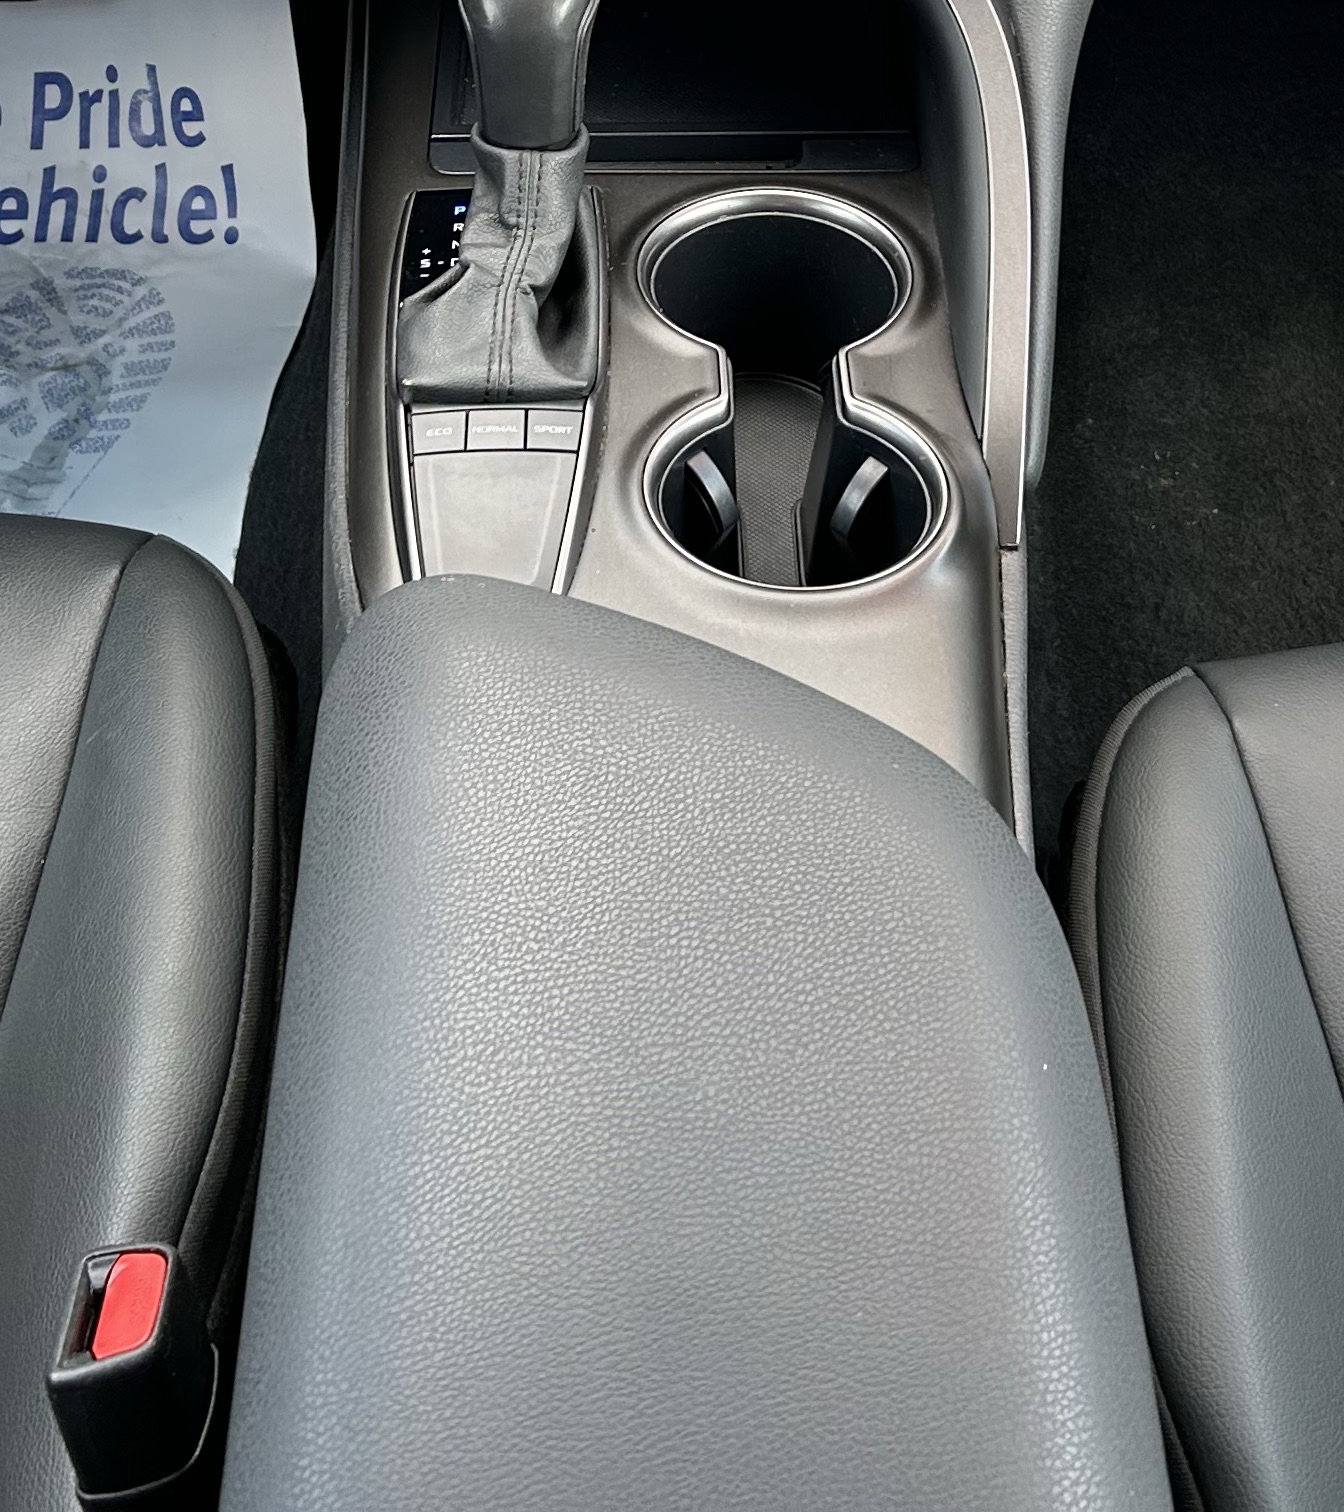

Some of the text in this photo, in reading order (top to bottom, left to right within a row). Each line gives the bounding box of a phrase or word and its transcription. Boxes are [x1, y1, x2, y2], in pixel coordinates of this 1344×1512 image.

[30, 64, 206, 151] Pride
[454, 205, 466, 216] P
[452, 222, 465, 232] R
[419, 258, 431, 268] S
[425, 427, 453, 437] ECO
[471, 424, 519, 435] NORMAL
[533, 424, 574, 435] SPORT
